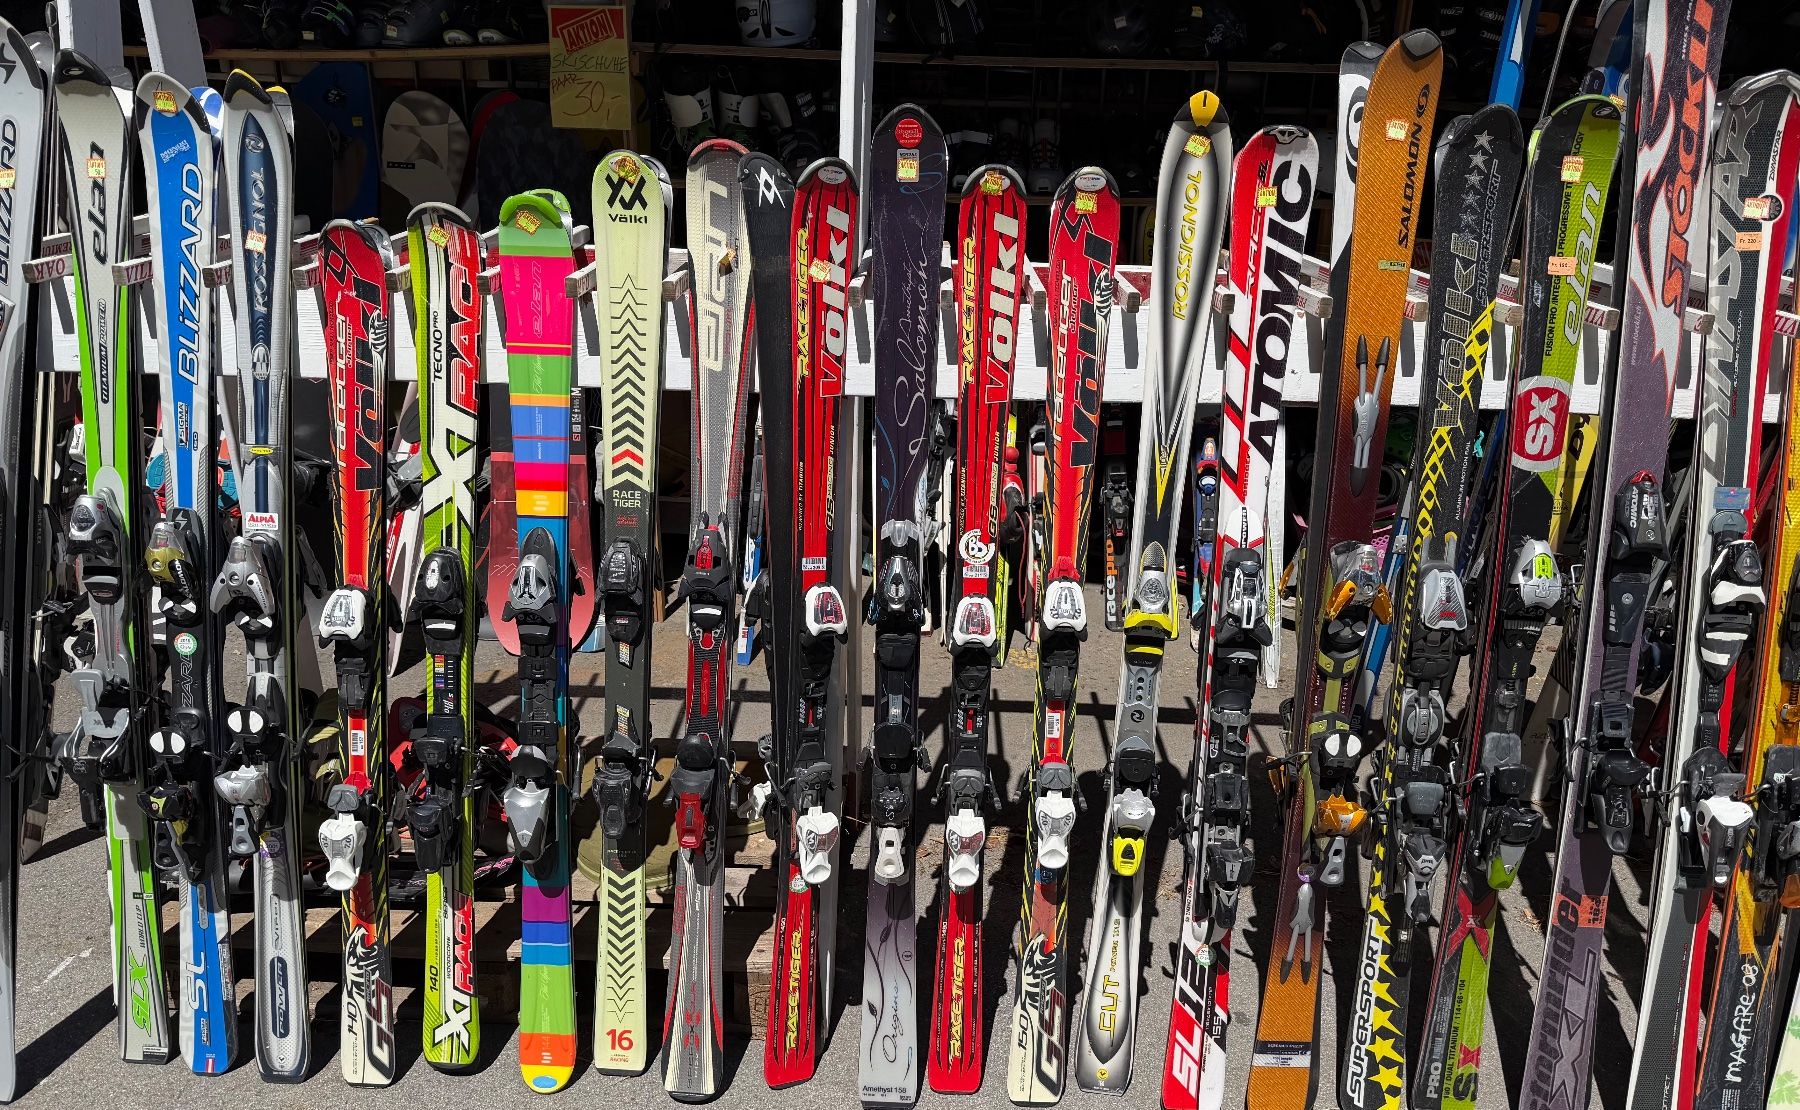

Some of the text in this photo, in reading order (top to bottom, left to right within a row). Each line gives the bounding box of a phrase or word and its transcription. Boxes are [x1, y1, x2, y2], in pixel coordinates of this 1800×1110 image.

[563, 13, 610, 51] AKTION
[1681, 33, 1690, 60] SWISS
[551, 53, 628, 71] SKISCHUHE
[1769, 130, 1784, 182] DYNASTAR
[1398, 126, 1422, 249] SALOMON
[608, 213, 648, 225] Völkl
[1476, 158, 1501, 307] SUPERSPORT
[1558, 194, 1571, 248] PROGRESSIVE
[1173, 170, 1202, 321] ROSSIGNOL
[1564, 180, 1602, 347] elan
[36, 258, 65, 280] OAK
[531, 260, 543, 339] elan
[1248, 160, 1311, 466] ATOMIC
[1550, 305, 1558, 323] PRO
[432, 328, 443, 380] TECNO
[1545, 323, 1556, 357] FUSION
[100, 345, 109, 404] TITANIUM
[178, 403, 187, 440] SIGMA
[1524, 391, 1559, 458] SX
[612, 490, 641, 499] RACE
[612, 500, 642, 508] TIGER
[1455, 483, 1465, 520] ALUMINUM
[1460, 456, 1468, 483] MOTION
[248, 513, 277, 525] ALPIA
[825, 498, 835, 531] GS
[987, 504, 998, 538] GS
[1629, 486, 1639, 529] ATOMIC
[134, 904, 147, 949] WORLD CUP
[186, 951, 209, 1013] SL
[429, 964, 439, 993] 140
[347, 1002, 358, 1036] 140
[1346, 914, 1383, 1109] SUPERSPORT
[605, 1028, 634, 1052] 16
[1018, 1013, 1029, 1051] 150
[1449, 1026, 1460, 1062] TITANIUM
[862, 1085, 893, 1095] Amethyst
[1426, 1061, 1443, 1099] PRO
